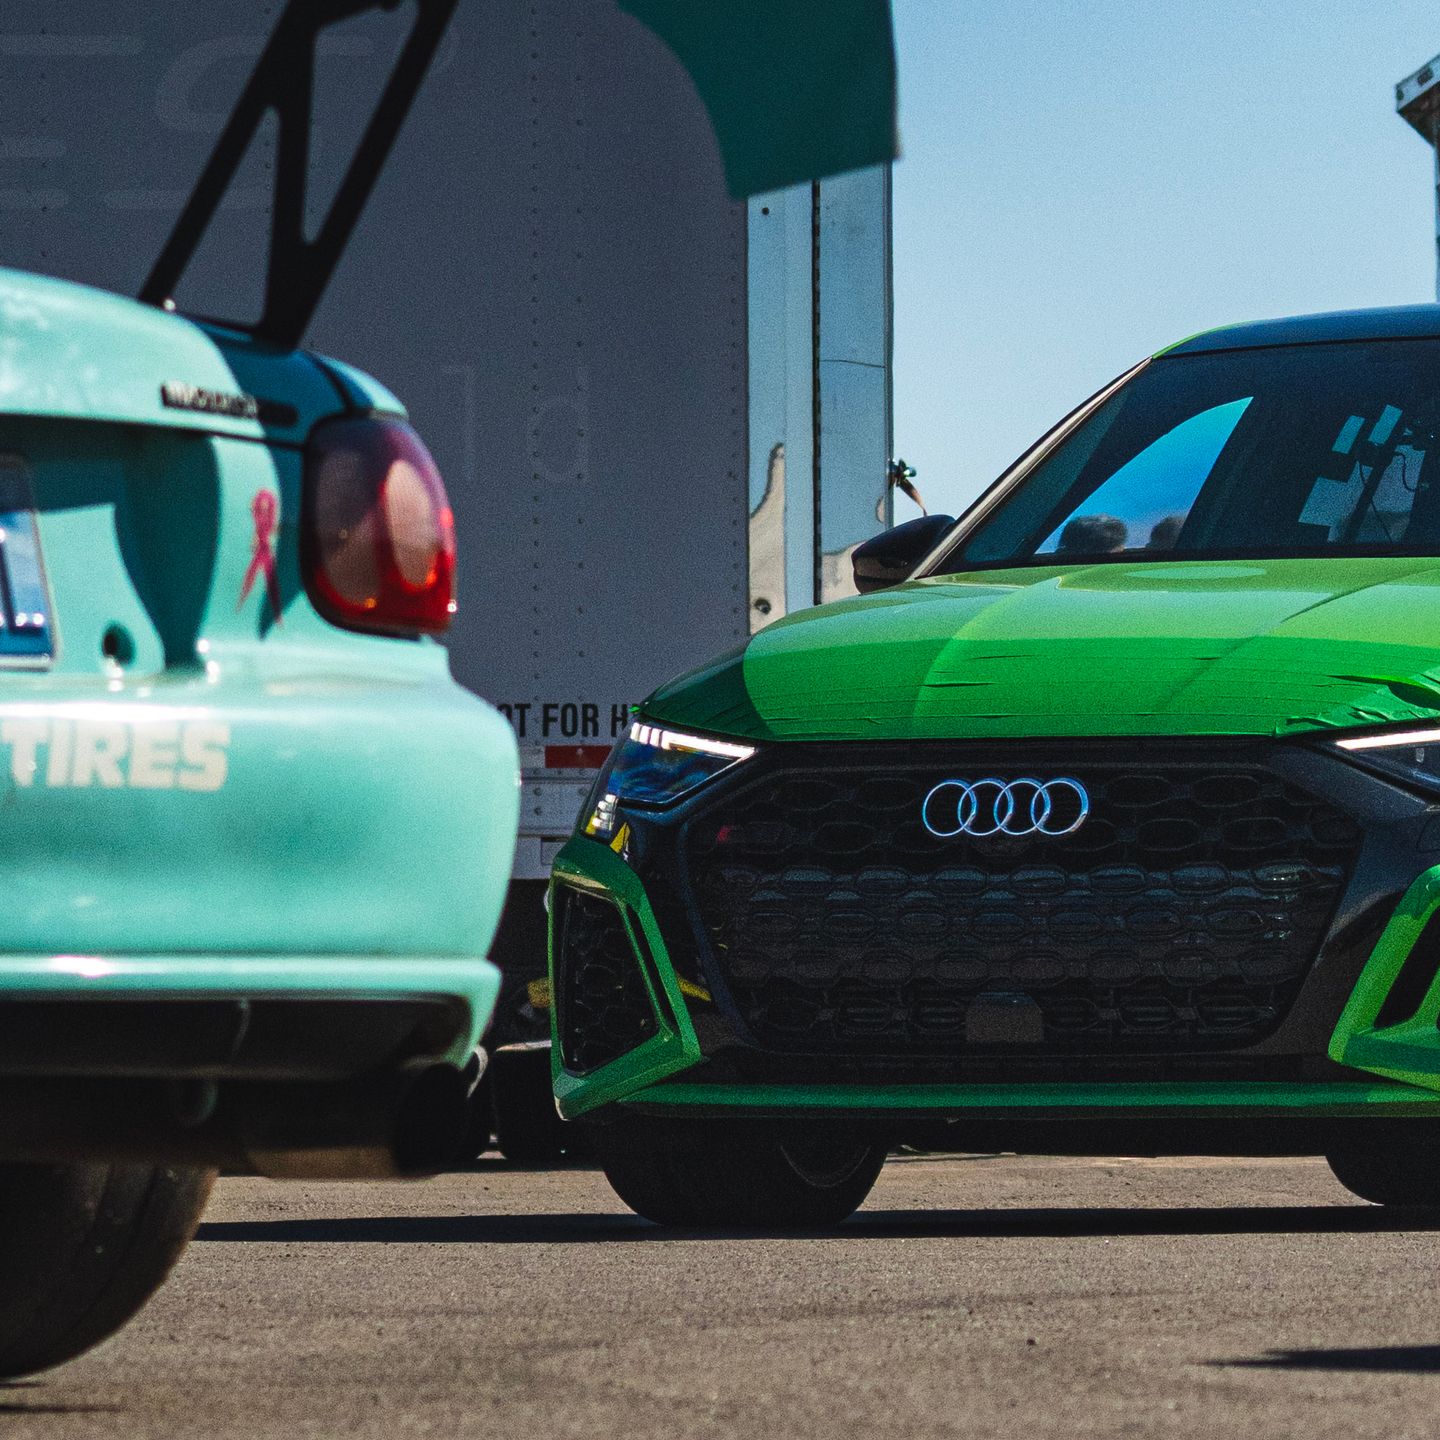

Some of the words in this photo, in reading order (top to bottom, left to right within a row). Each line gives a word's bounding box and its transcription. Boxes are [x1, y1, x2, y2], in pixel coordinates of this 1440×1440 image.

[542, 703, 599, 738] FOR
[610, 703, 640, 738] H
[1, 717, 231, 792] TIRES
